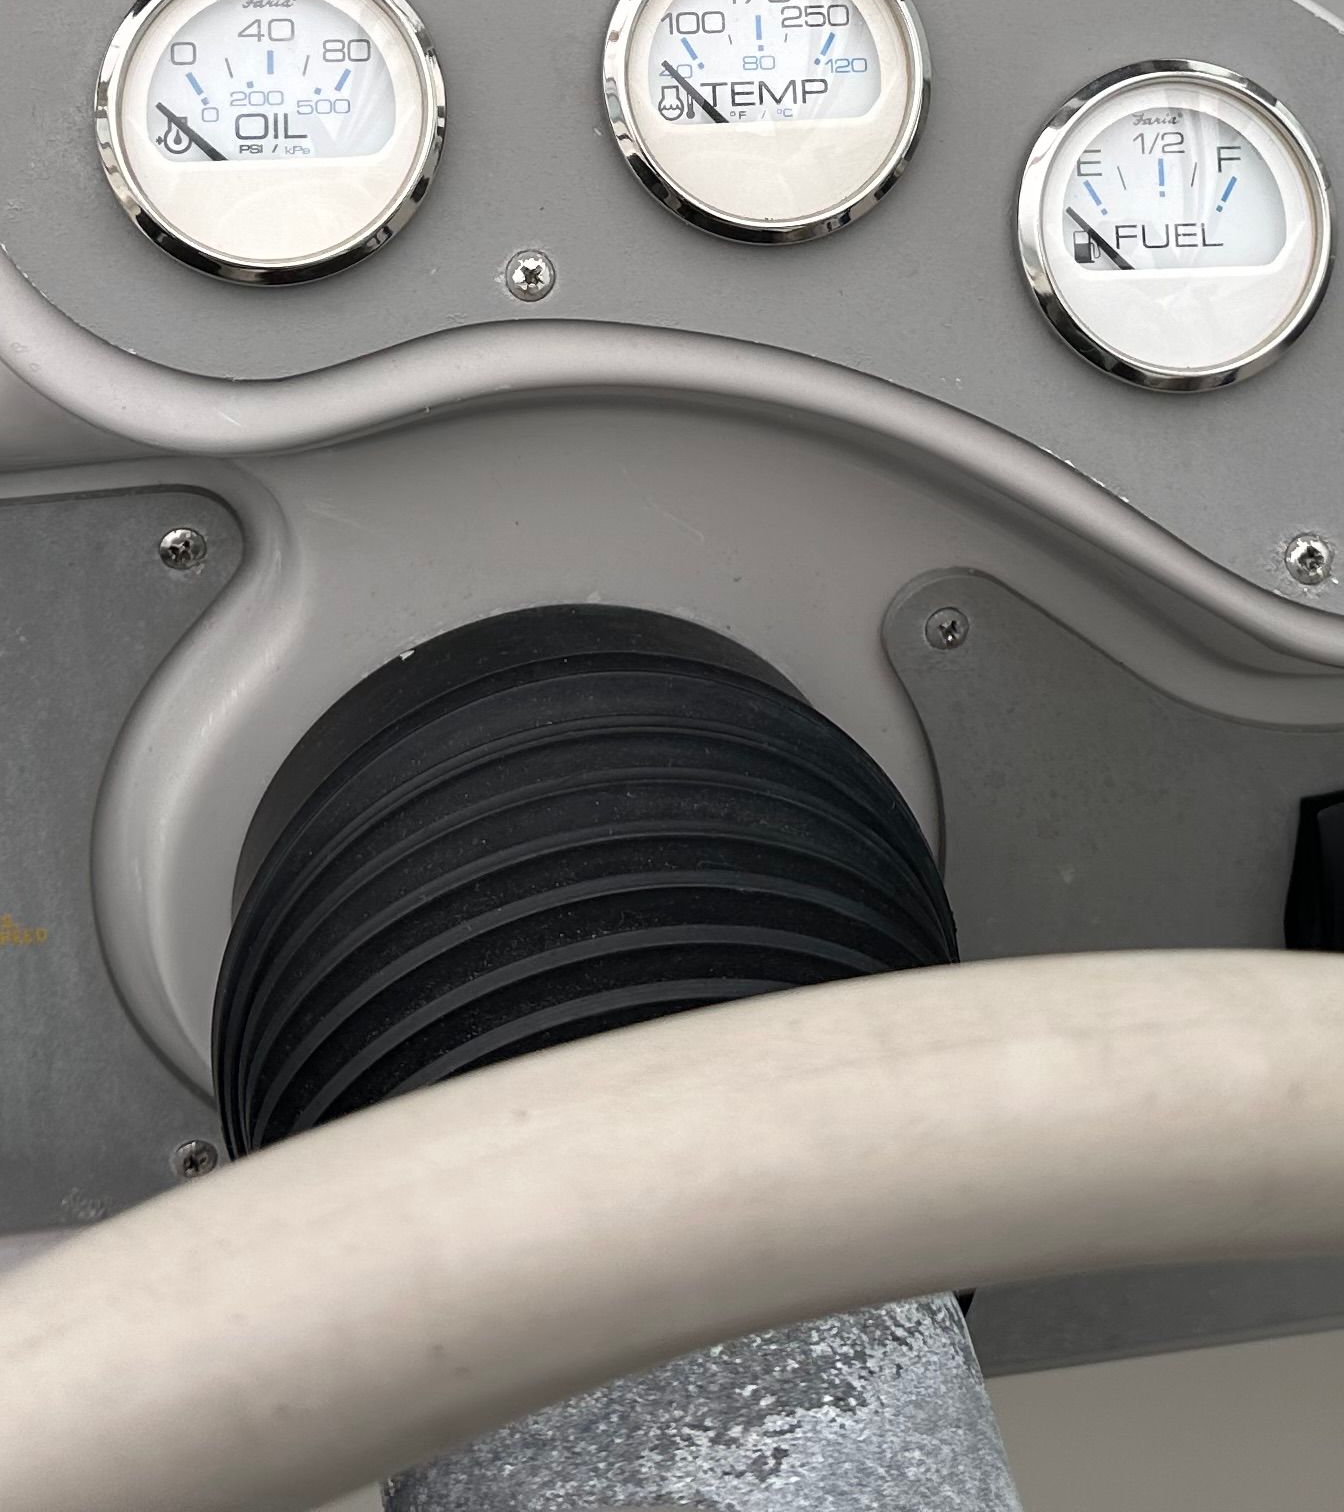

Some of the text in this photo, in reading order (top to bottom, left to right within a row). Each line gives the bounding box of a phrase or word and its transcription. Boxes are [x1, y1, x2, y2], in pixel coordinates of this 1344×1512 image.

[660, 11, 726, 35] 100
[781, 5, 850, 28] 250
[237, 19, 295, 42] 40
[170, 42, 197, 65] 0
[322, 39, 371, 63] 80
[742, 56, 775, 71] 80
[824, 58, 868, 74] 120
[230, 91, 284, 106] 200
[700, 79, 828, 108] TEMP
[201, 107, 219, 122] 0
[296, 99, 351, 116] 500
[235, 113, 308, 140] OIL
[239, 144, 263, 154] PSI
[285, 145, 310, 155] kPa
[1132, 132, 1185, 155] 1/2
[1076, 149, 1102, 177] E
[1216, 146, 1241, 173] F
[1114, 223, 1224, 249] FUEL
